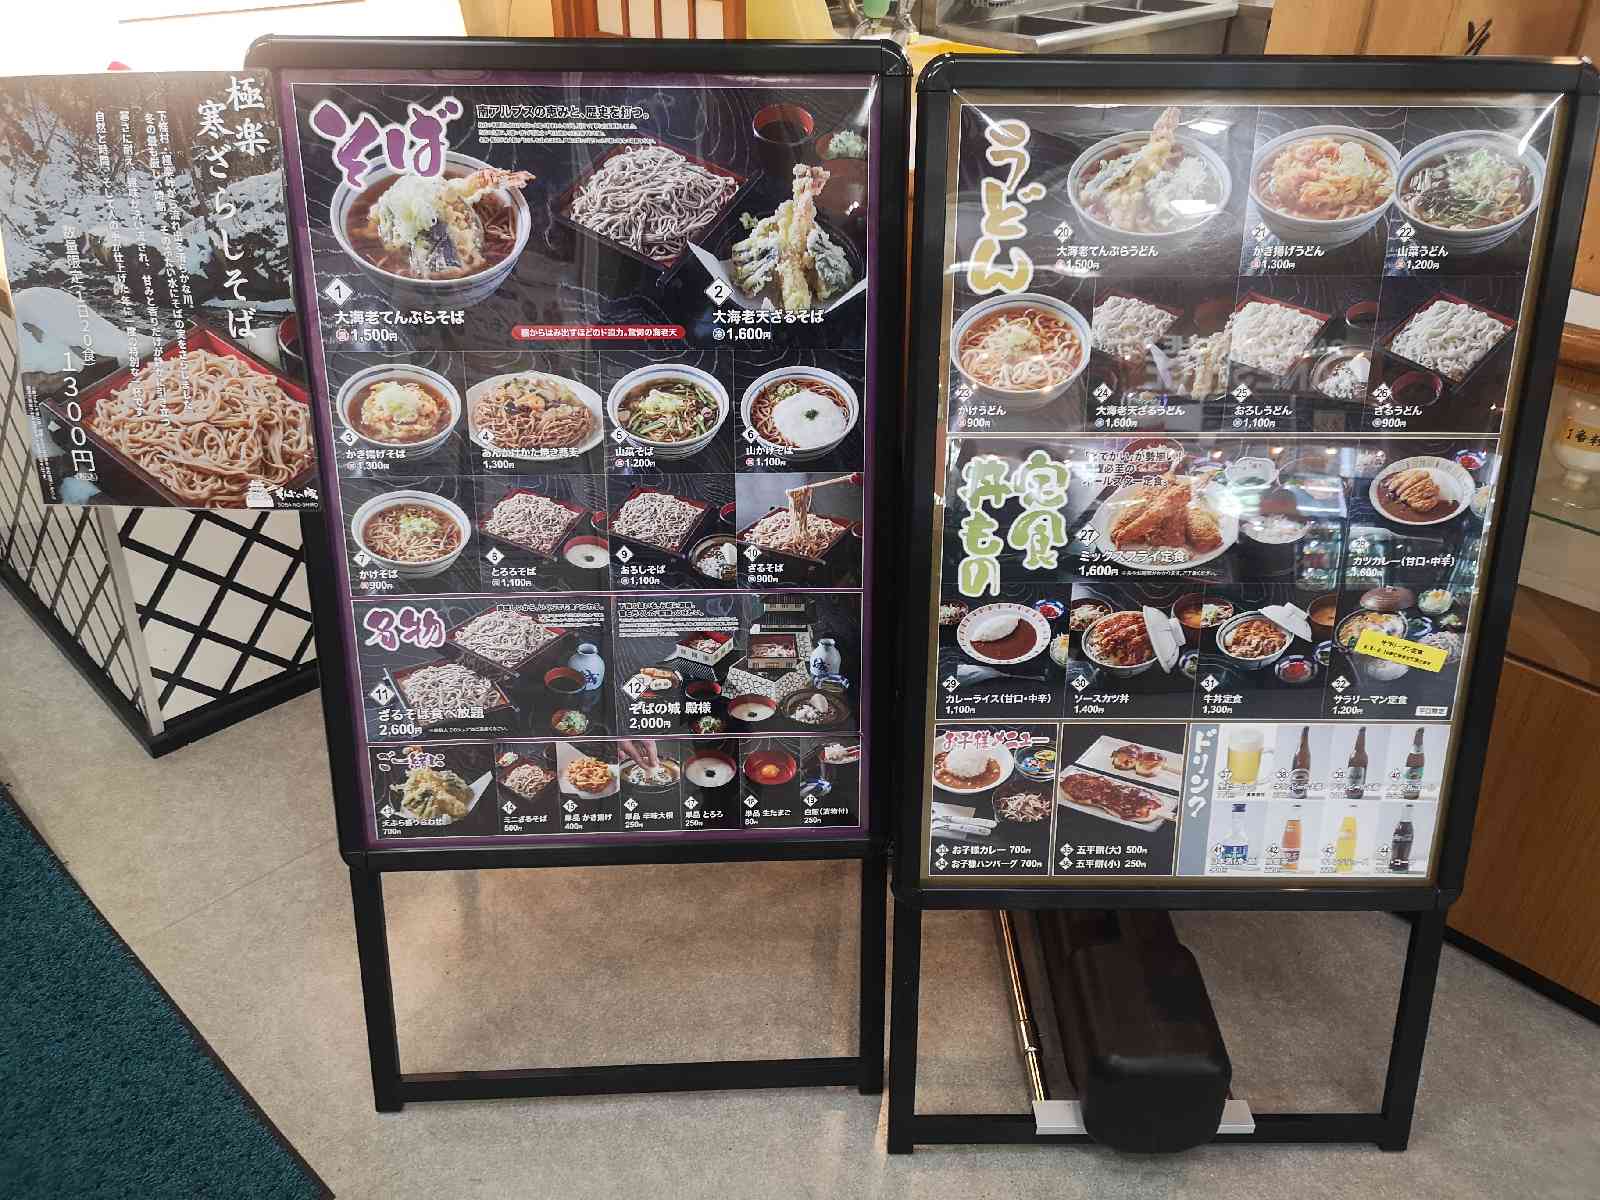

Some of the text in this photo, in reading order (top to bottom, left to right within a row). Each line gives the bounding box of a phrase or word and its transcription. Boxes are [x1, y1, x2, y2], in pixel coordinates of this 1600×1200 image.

[224, 75, 270, 157] 極楽
[309, 96, 463, 190] そば
[967, 120, 1047, 295] うどん
[196, 99, 258, 339] 寒ざらしそば
[1397, 245, 1448, 257] 山菜うどん
[712, 309, 825, 324] 大海老天ざるそば
[726, 327, 771, 341] 1,600円
[62, 352, 95, 472] 1300円
[1233, 406, 1293, 416] おろしうどん
[1007, 450, 1072, 570] 定食
[1079, 550, 1186, 563] ミックスフライ定食
[358, 569, 399, 579] かけそば
[491, 567, 537, 577] とろろそば
[620, 565, 666, 575] おろしそば
[747, 563, 785, 573] ざるそば
[1078, 565, 1119, 577] 1,600円
[363, 607, 447, 651] 名物
[1203, 694, 1243, 704] 牛丼定食
[1334, 695, 1408, 705] サラリーマン定食
[378, 706, 485, 720] ざるそば食べ放題
[629, 701, 712, 715] そばの城 殿様
[945, 705, 976, 714] 1,100円
[1073, 705, 1105, 714] 1,400円
[1202, 705, 1233, 714] 1,300円
[379, 723, 422, 736] 2,600円
[629, 717, 671, 729] 2,000円
[1188, 728, 1217, 818] ドリンク
